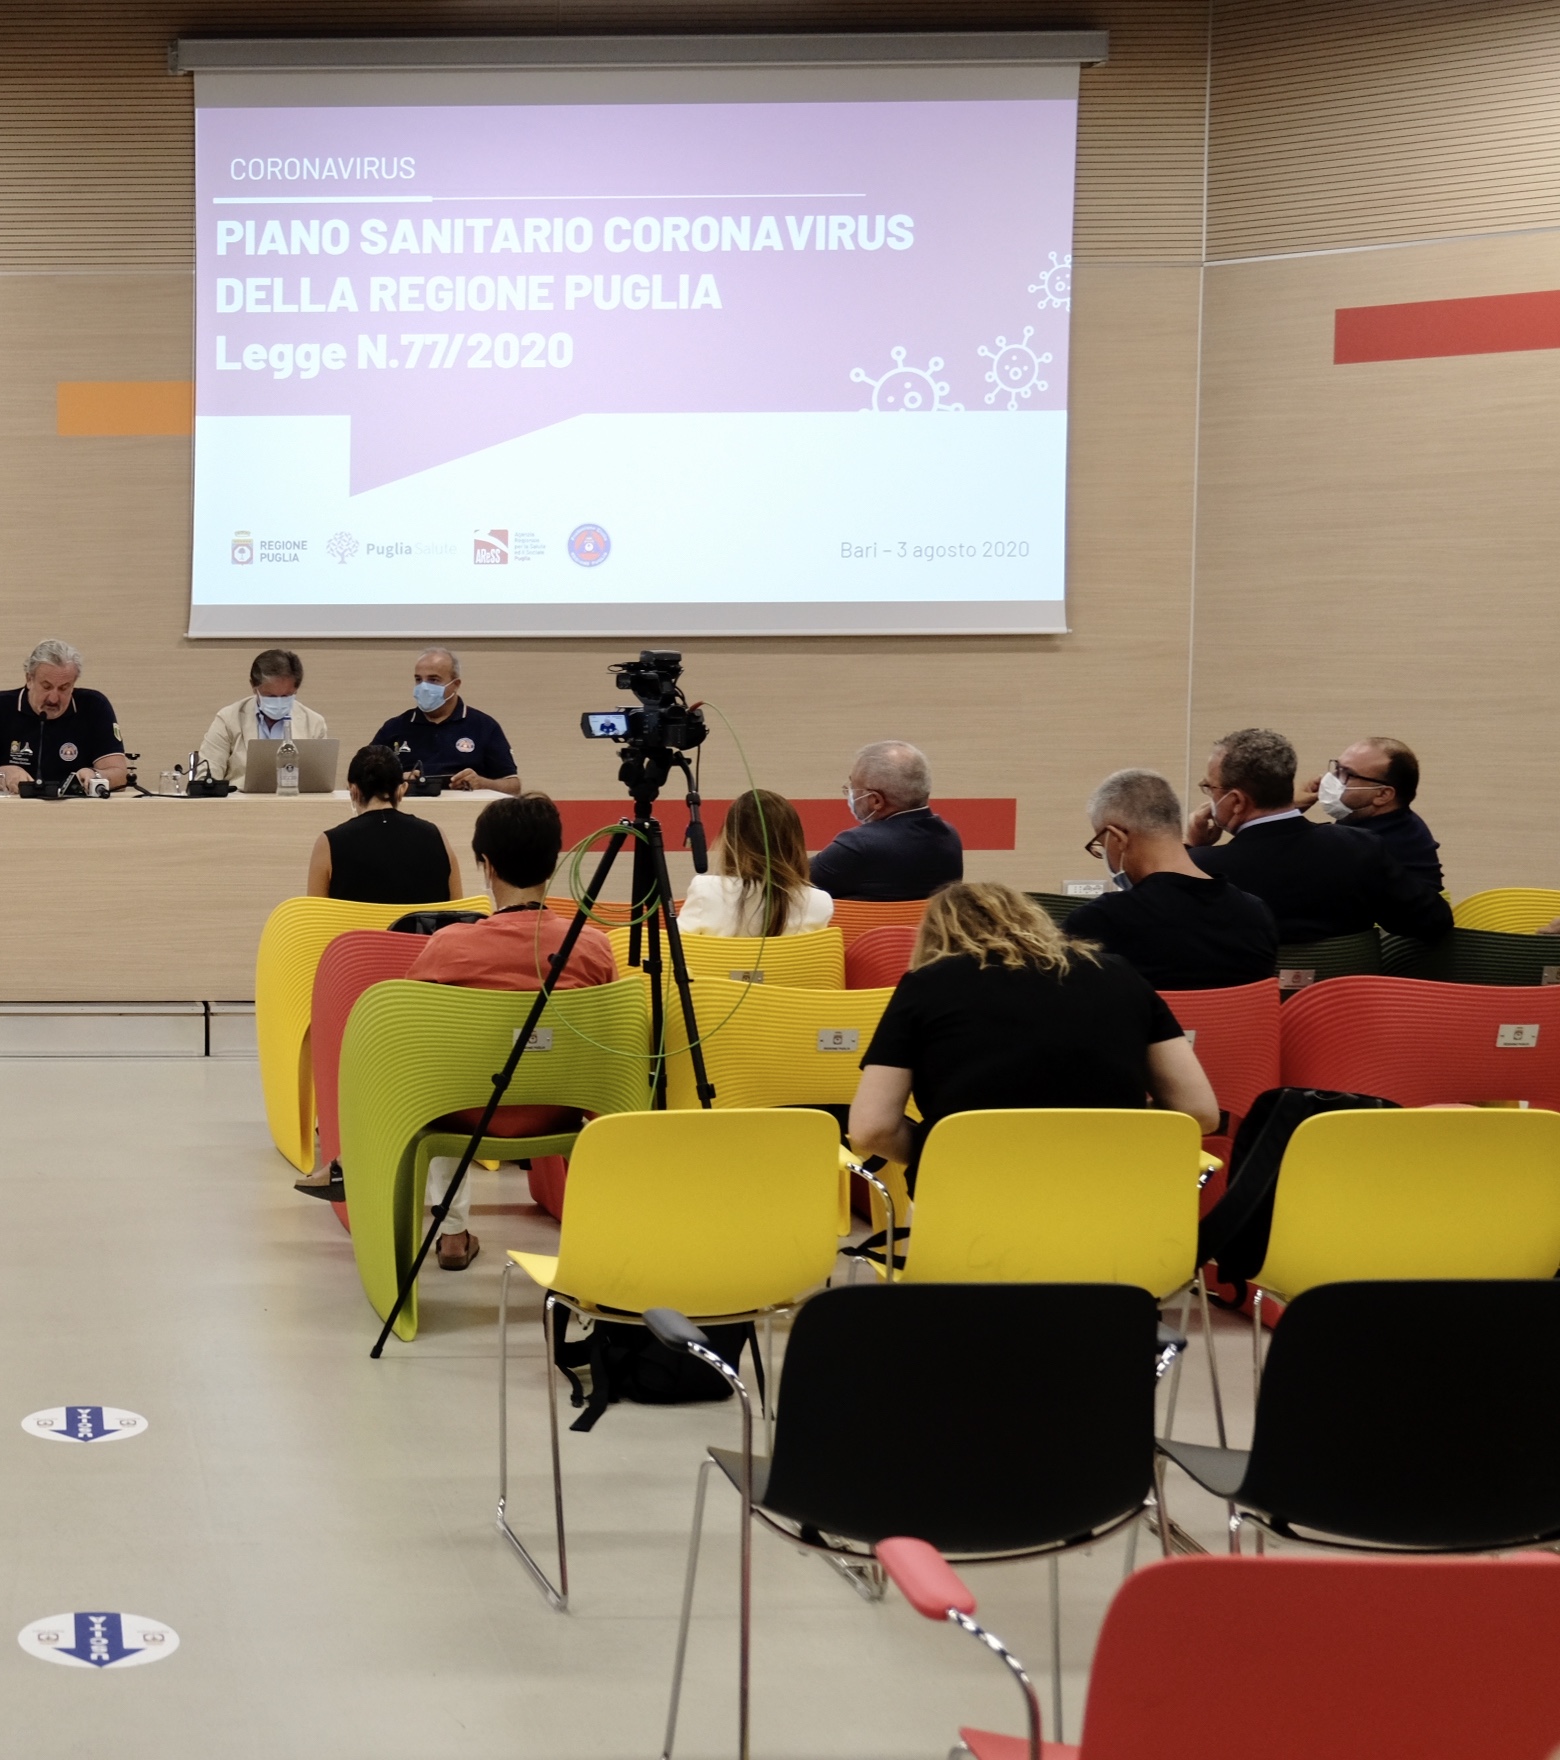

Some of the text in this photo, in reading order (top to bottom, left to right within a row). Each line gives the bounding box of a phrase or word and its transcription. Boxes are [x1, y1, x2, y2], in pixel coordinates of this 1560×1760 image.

[231, 157, 415, 180] CORONAVIRUS
[217, 215, 913, 255] PIANO SANITARIO CORONAVIRUS
[217, 274, 722, 312] DELLA REGIONE PUGLIA
[217, 332, 573, 379] Legge N.77/2020
[260, 540, 308, 551] REGIONE
[366, 541, 457, 558] Puglia Salute
[841, 542, 877, 558] Bari
[897, 542, 906, 557] 3
[913, 544, 976, 561] agosto
[983, 541, 1029, 557] 2020
[260, 552, 300, 562] PUGLIA
